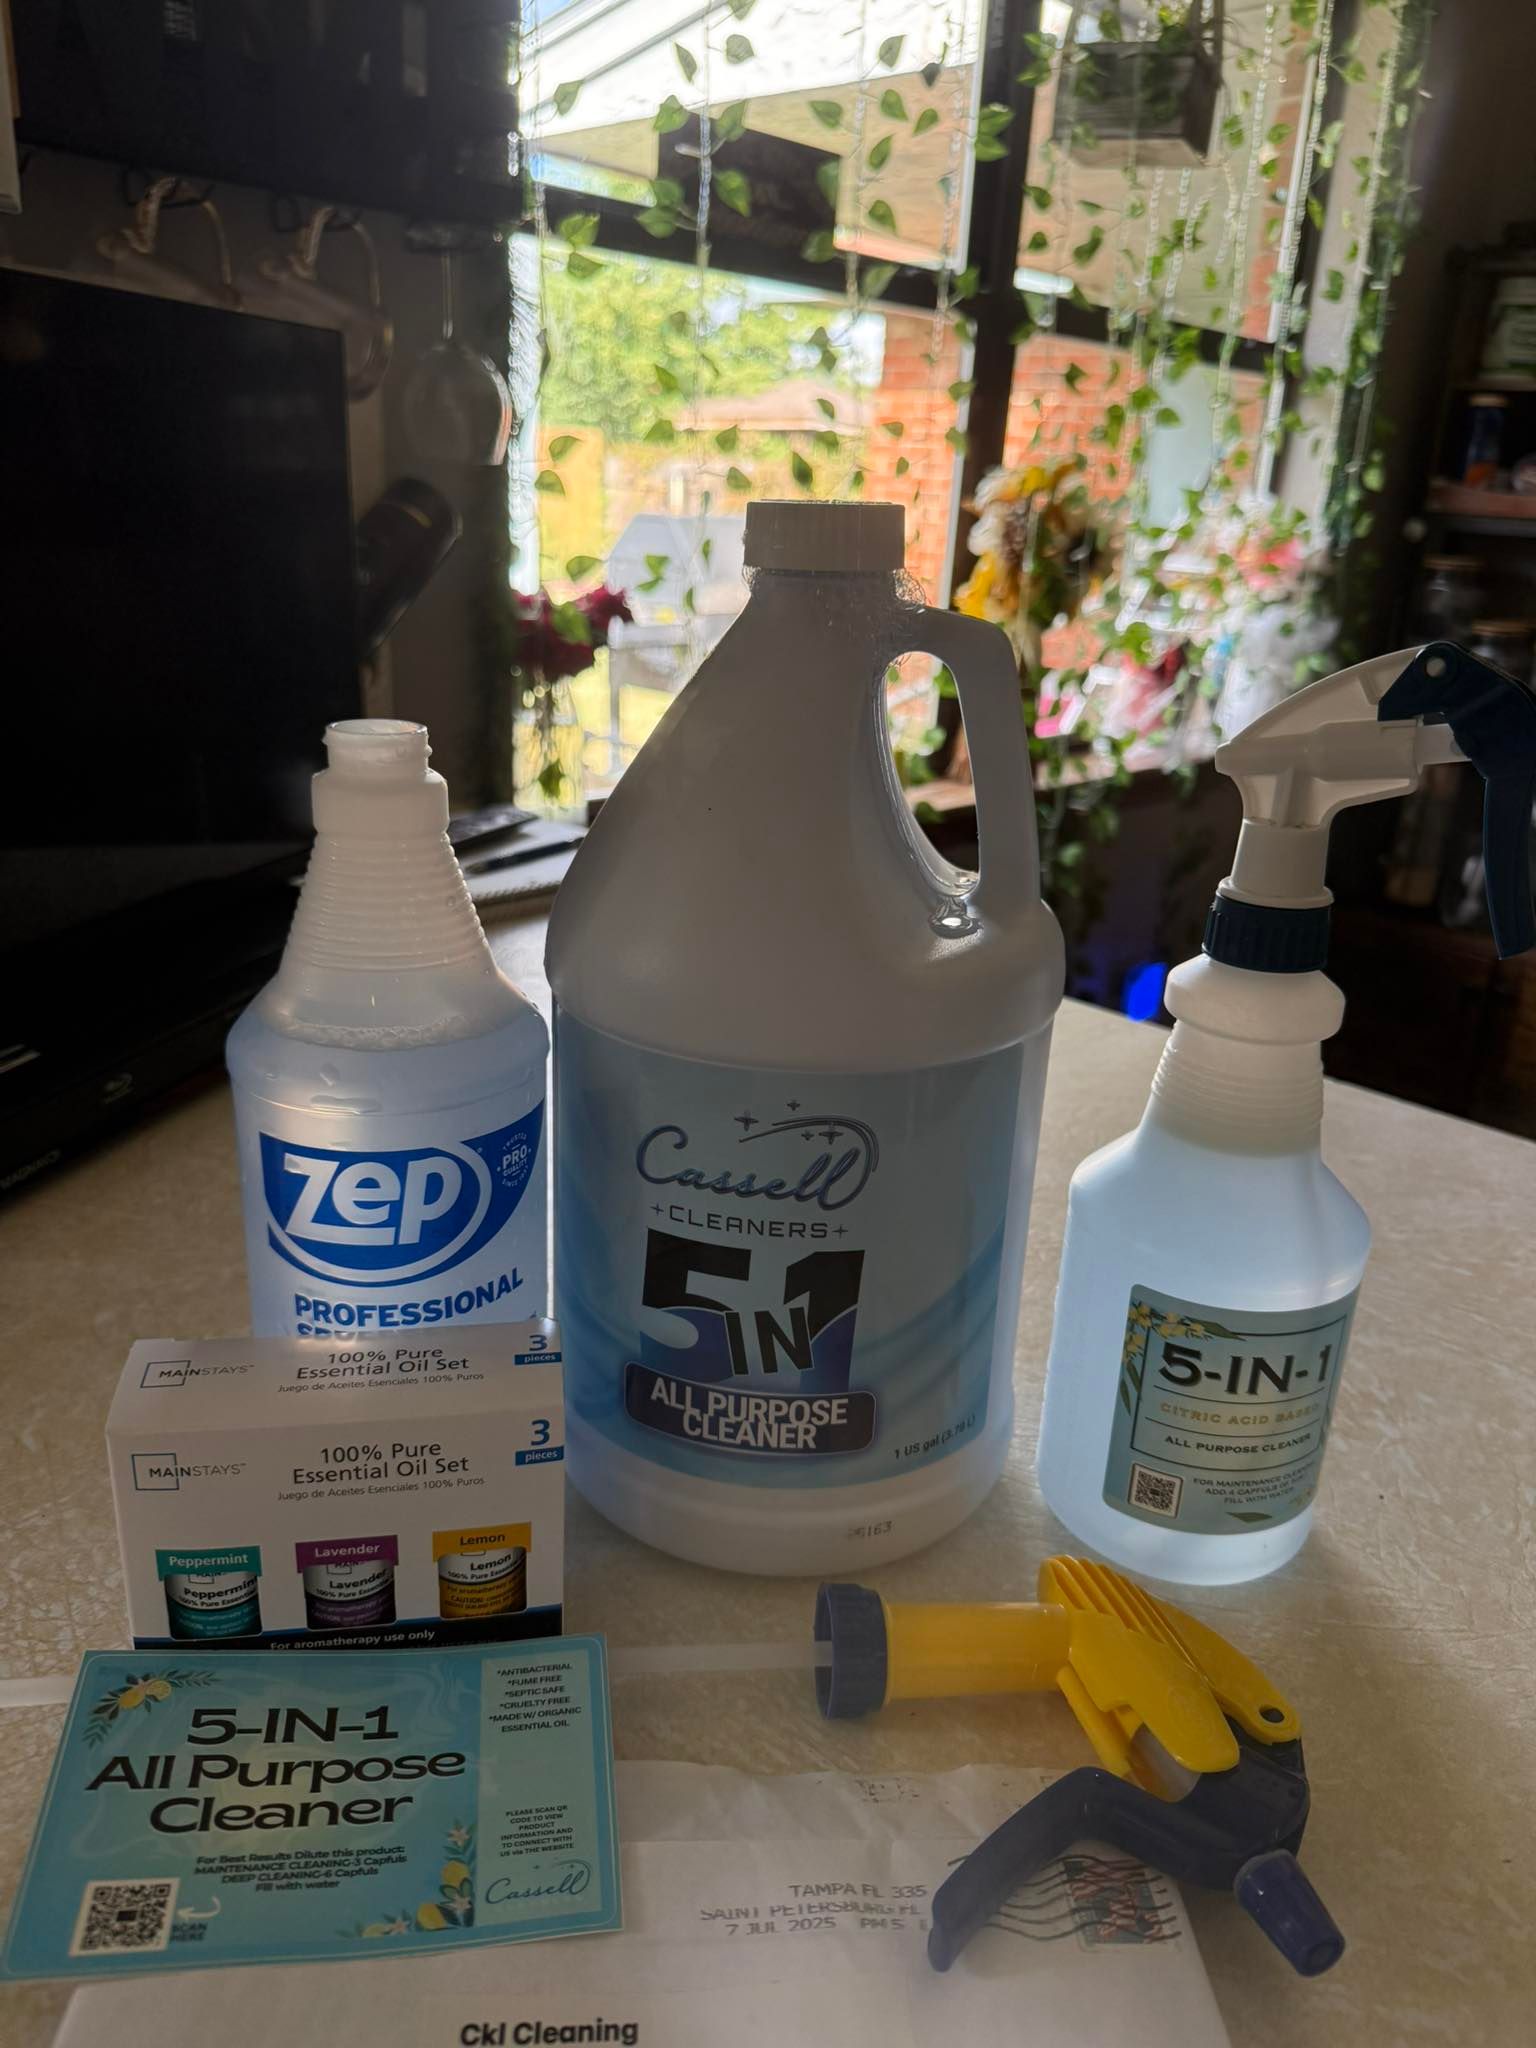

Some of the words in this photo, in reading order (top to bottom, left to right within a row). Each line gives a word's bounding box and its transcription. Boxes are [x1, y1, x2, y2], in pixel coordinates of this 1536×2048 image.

[502, 1145, 528, 1169] PRO
[636, 1116, 880, 1211] Cassell
[669, 1204, 829, 1238] CLEANERS
[295, 1268, 524, 1327] PROFESSIONAL
[641, 1227, 752, 1384] 5
[725, 1306, 814, 1375] IN
[783, 1249, 866, 1393] 1
[529, 1335, 548, 1351] 3
[329, 1351, 387, 1364] 100%
[395, 1349, 443, 1360] Pure
[159, 1366, 249, 1378] MAINSTAYS
[296, 1362, 391, 1380] Essential
[398, 1359, 429, 1374] Oil
[434, 1357, 470, 1370] Set
[1158, 1341, 1332, 1395] 5-IN-1
[277, 1384, 308, 1393] Juego
[311, 1382, 325, 1390] de
[329, 1380, 365, 1390] Aceites
[368, 1378, 418, 1387] Esenciales
[424, 1374, 453, 1383] 100%
[457, 1373, 484, 1381] Puros
[651, 1377, 702, 1416] ALL
[708, 1391, 849, 1426] PURPOSE
[1160, 1402, 1221, 1424] CITRIC
[1227, 1414, 1270, 1425] ACID
[530, 1419, 551, 1446] 3
[683, 1406, 817, 1449] CLEANER
[321, 1444, 382, 1464] 100%
[393, 1442, 442, 1459] Pure
[904, 1442, 921, 1457] US
[922, 1433, 940, 1452] gal
[1165, 1435, 1191, 1449] ALL
[1196, 1442, 1258, 1453] PURPOSE
[1262, 1433, 1311, 1452] CLEANER
[525, 1450, 557, 1462] pieces
[150, 1464, 242, 1478] MAINSTAYS
[293, 1462, 389, 1485] Essential
[397, 1460, 428, 1476] Oil
[436, 1457, 469, 1473] Set
[1193, 1477, 1214, 1486] FOR
[1216, 1475, 1282, 1487] MAINTENANCE
[278, 1490, 309, 1501] Juego
[312, 1488, 325, 1498] de
[328, 1486, 365, 1496] Aceites
[368, 1482, 419, 1494] Esenciales
[423, 1479, 453, 1490] 100%
[457, 1477, 485, 1487] Puros
[460, 1533, 506, 1546] Lemon
[169, 1552, 249, 1569] Peppermint
[315, 1544, 380, 1558] Lavender
[470, 1554, 513, 1571] Lemon
[329, 1568, 387, 1589] Lavender
[271, 1642, 290, 1651] For
[294, 1634, 380, 1648] aromatherapy
[384, 1634, 404, 1642] use
[409, 1629, 435, 1641] only
[540, 1675, 562, 1684] FREE
[543, 1686, 565, 1695] SAFE
[547, 1696, 570, 1705] FREE
[537, 1706, 582, 1717] ORGANIC
[187, 1706, 399, 1745] 5-IN-1
[501, 1721, 552, 1733] ESSENTIAL
[85, 1755, 176, 1791] All
[188, 1752, 466, 1793] Purpose
[150, 1796, 414, 1833] Cleaner
[506, 1808, 533, 1817] PLEASE
[510, 1816, 531, 1824] CODE
[501, 1829, 555, 1841] INFORMATION
[556, 1827, 573, 1835] AND
[518, 1822, 555, 1831] PRODUCT
[502, 1841, 513, 1849] TO
[514, 1837, 551, 1847] CONNECT
[552, 1834, 572, 1842] WITH
[194, 1863, 286, 1875] MAINTENANCE
[363, 1854, 408, 1866] Capfuls
[196, 1855, 218, 1865] For
[220, 1854, 247, 1864] Best
[249, 1852, 292, 1863] Results
[295, 1849, 330, 1861] Dilute
[332, 1848, 353, 1858] this
[222, 1874, 257, 1885] DEEP
[335, 1867, 379, 1878] Capfuls
[275, 1881, 302, 1891] with
[305, 1880, 341, 1890] water
[485, 1860, 592, 1904] Cassell
[788, 1883, 858, 1899] TAMPA
[862, 1885, 884, 1899] FL
[891, 1885, 928, 1899] 335
[700, 1906, 759, 1922] SAINT
[770, 1900, 896, 1918] PETERSBURG
[899, 1904, 921, 1916] FL
[725, 1923, 740, 1936] 7
[746, 1920, 780, 1936] JUL
[787, 1916, 838, 1932] 2025
[860, 1918, 888, 1930] PM
[513, 2017, 639, 2047] Cleaning
